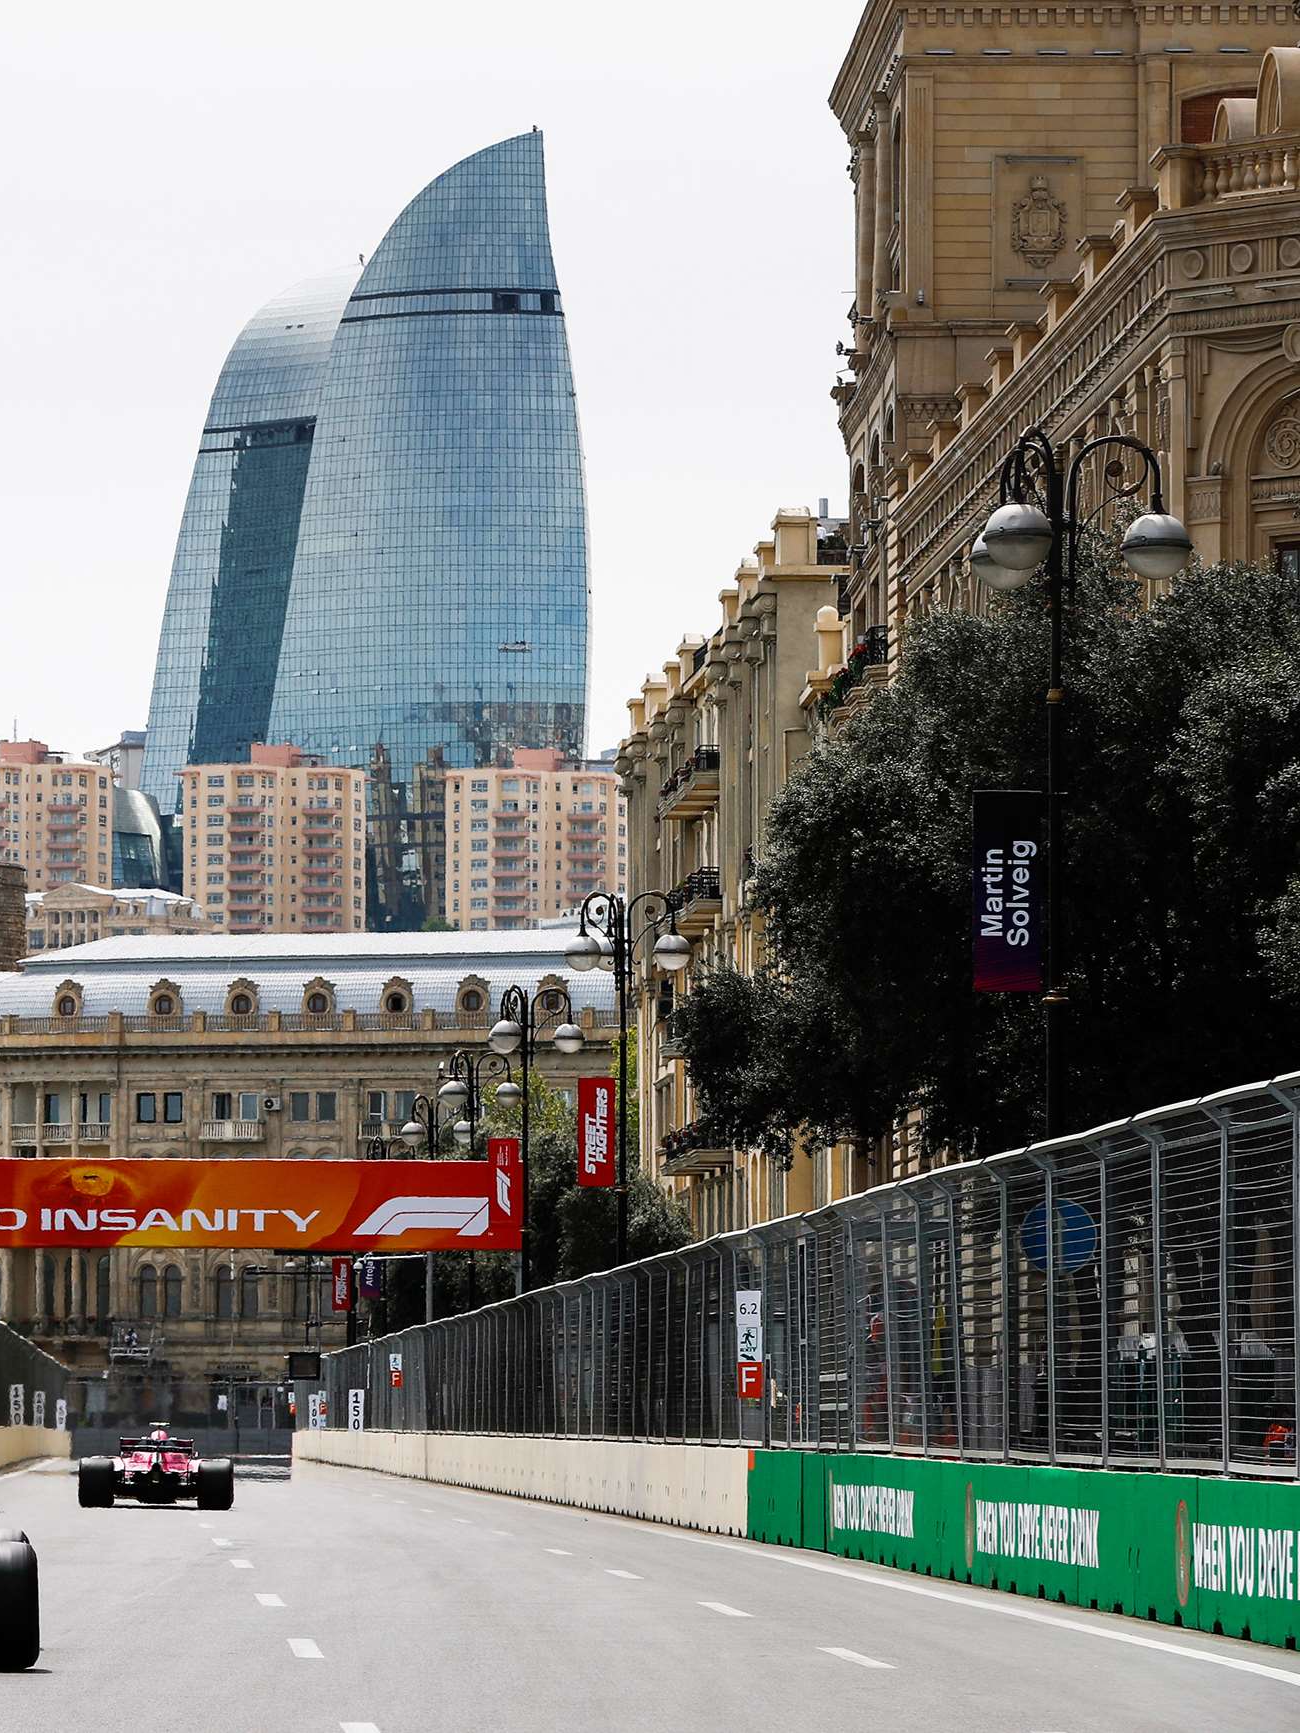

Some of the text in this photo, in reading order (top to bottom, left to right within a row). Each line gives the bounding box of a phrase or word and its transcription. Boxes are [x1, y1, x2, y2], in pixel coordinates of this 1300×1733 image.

[981, 848, 1003, 937] Martin
[1006, 840, 1037, 946] Solveig
[584, 1113, 597, 1174] STREET
[595, 1087, 608, 1163] FIGHTERS
[40, 1207, 321, 1232] INSANITY
[365, 1260, 376, 1287] Afroja
[739, 1302, 758, 1315] 6.2
[391, 1372, 400, 1386] F
[741, 1366, 758, 1393] F
[13, 1386, 21, 1425] 150
[352, 1391, 361, 1431] 150
[976, 1499, 1099, 1568] WHEN YOU DRIVE NEVER DRINK
[1192, 1522, 1226, 1592] WHEN
[1228, 1525, 1255, 1597] YOU
[1258, 1527, 1294, 1600] DRIVE
